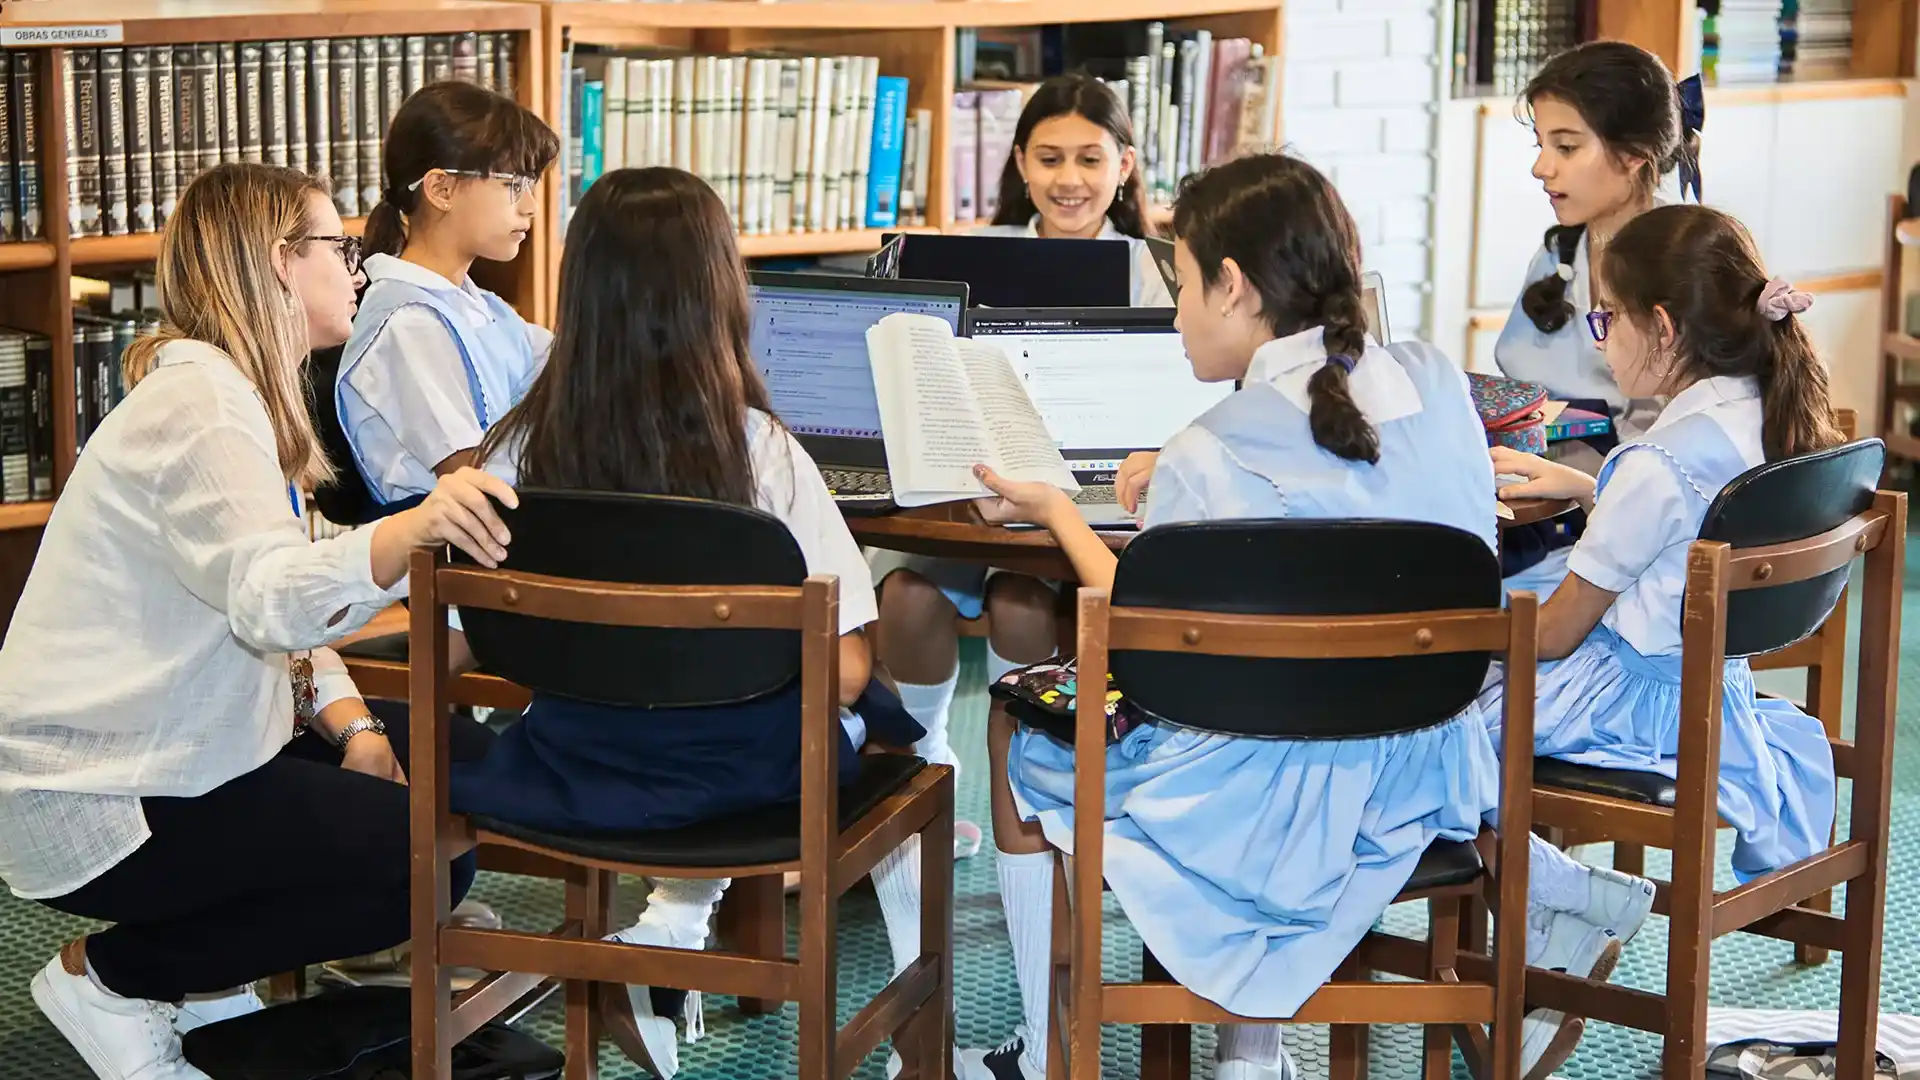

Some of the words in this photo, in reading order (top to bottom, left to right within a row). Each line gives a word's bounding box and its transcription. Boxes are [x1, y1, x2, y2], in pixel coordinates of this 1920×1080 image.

[15, 31, 48, 40] OBRAS
[51, 29, 108, 39] GENERALES
[24, 83, 36, 153] Britannica
[80, 79, 92, 149] Britannica
[109, 78, 122, 148] Britannica
[135, 76, 147, 146] Britannica
[159, 75, 170, 145] Britannica
[180, 75, 193, 143] Britannica
[203, 74, 216, 142] Britannica
